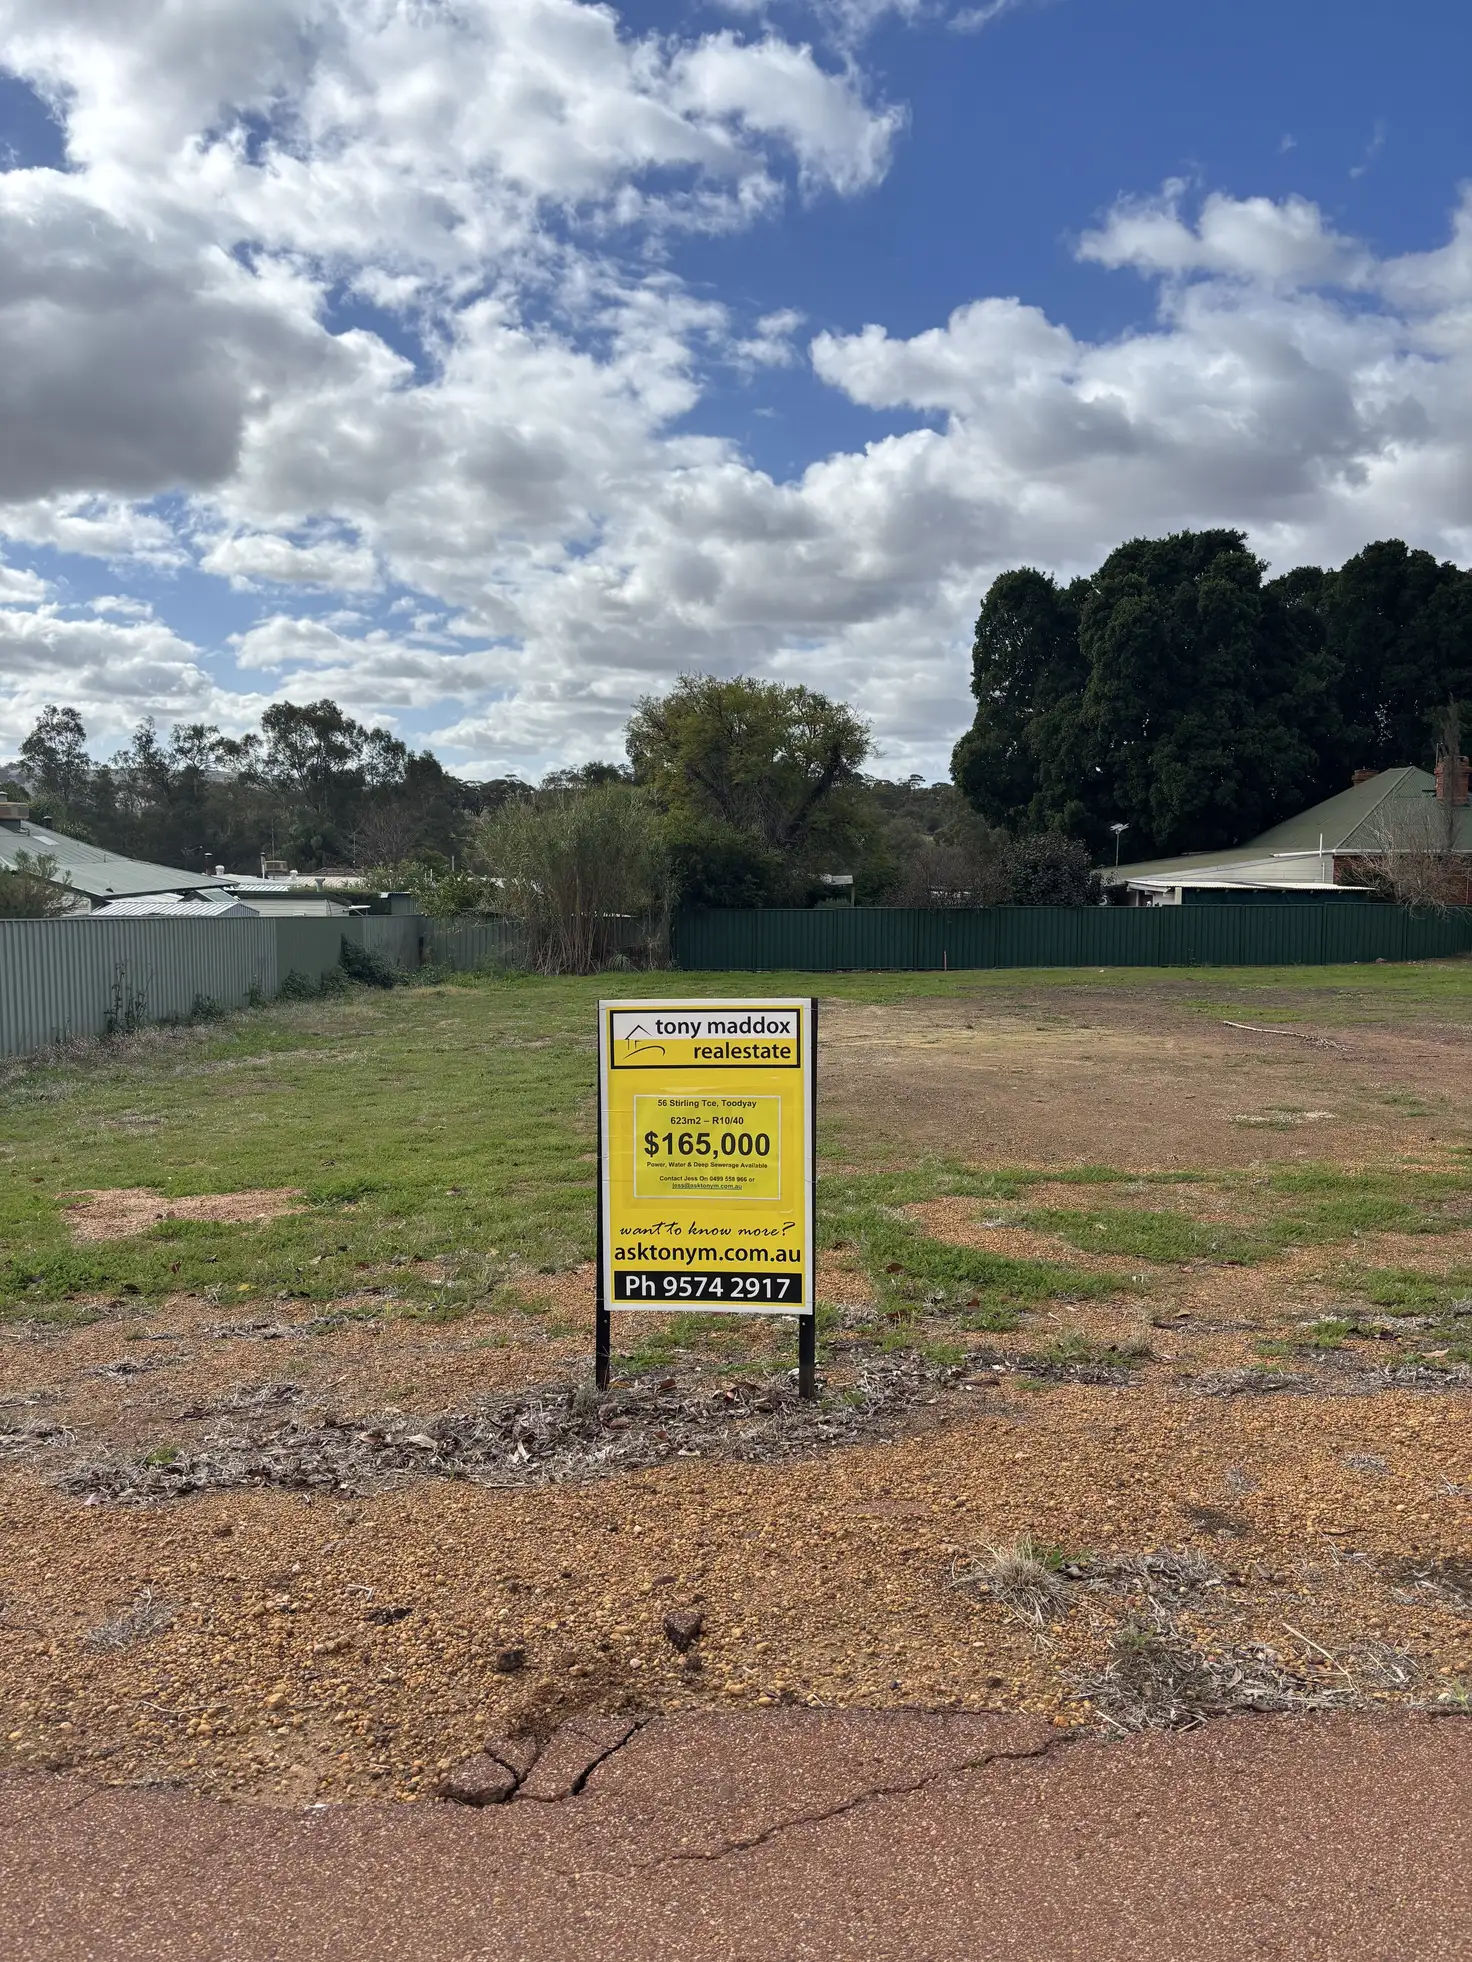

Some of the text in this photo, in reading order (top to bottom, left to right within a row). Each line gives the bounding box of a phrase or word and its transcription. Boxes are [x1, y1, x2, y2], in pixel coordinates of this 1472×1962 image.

[655, 1016, 791, 1039] tony maddox
[694, 1042, 791, 1059] realestate
[657, 1099, 757, 1108] 56 Stirling Tce, Toodyay
[670, 1116, 701, 1125] 623m2
[712, 1116, 744, 1125] R10/40
[644, 1131, 770, 1159] $165,000
[620, 1221, 796, 1236] want to know more?
[614, 1242, 801, 1265] asktonym.com.au
[625, 1274, 791, 1299] Ph 9574 2917
